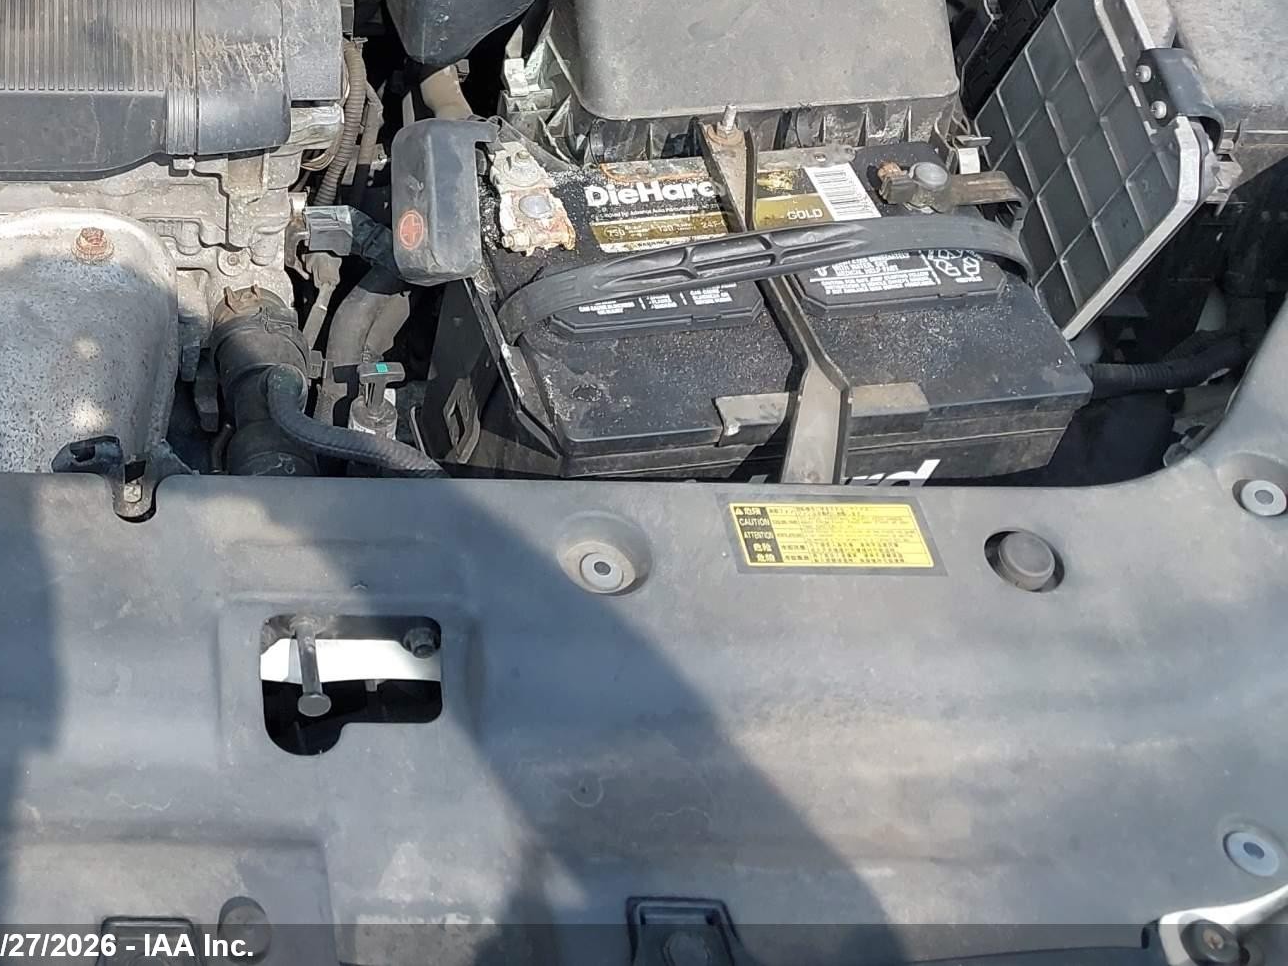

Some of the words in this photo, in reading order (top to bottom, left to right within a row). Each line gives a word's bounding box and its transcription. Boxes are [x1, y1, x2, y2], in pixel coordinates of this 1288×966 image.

[787, 208, 824, 221] GOLD
[738, 517, 770, 527] CAUTION
[744, 531, 775, 539] ATTENTION
